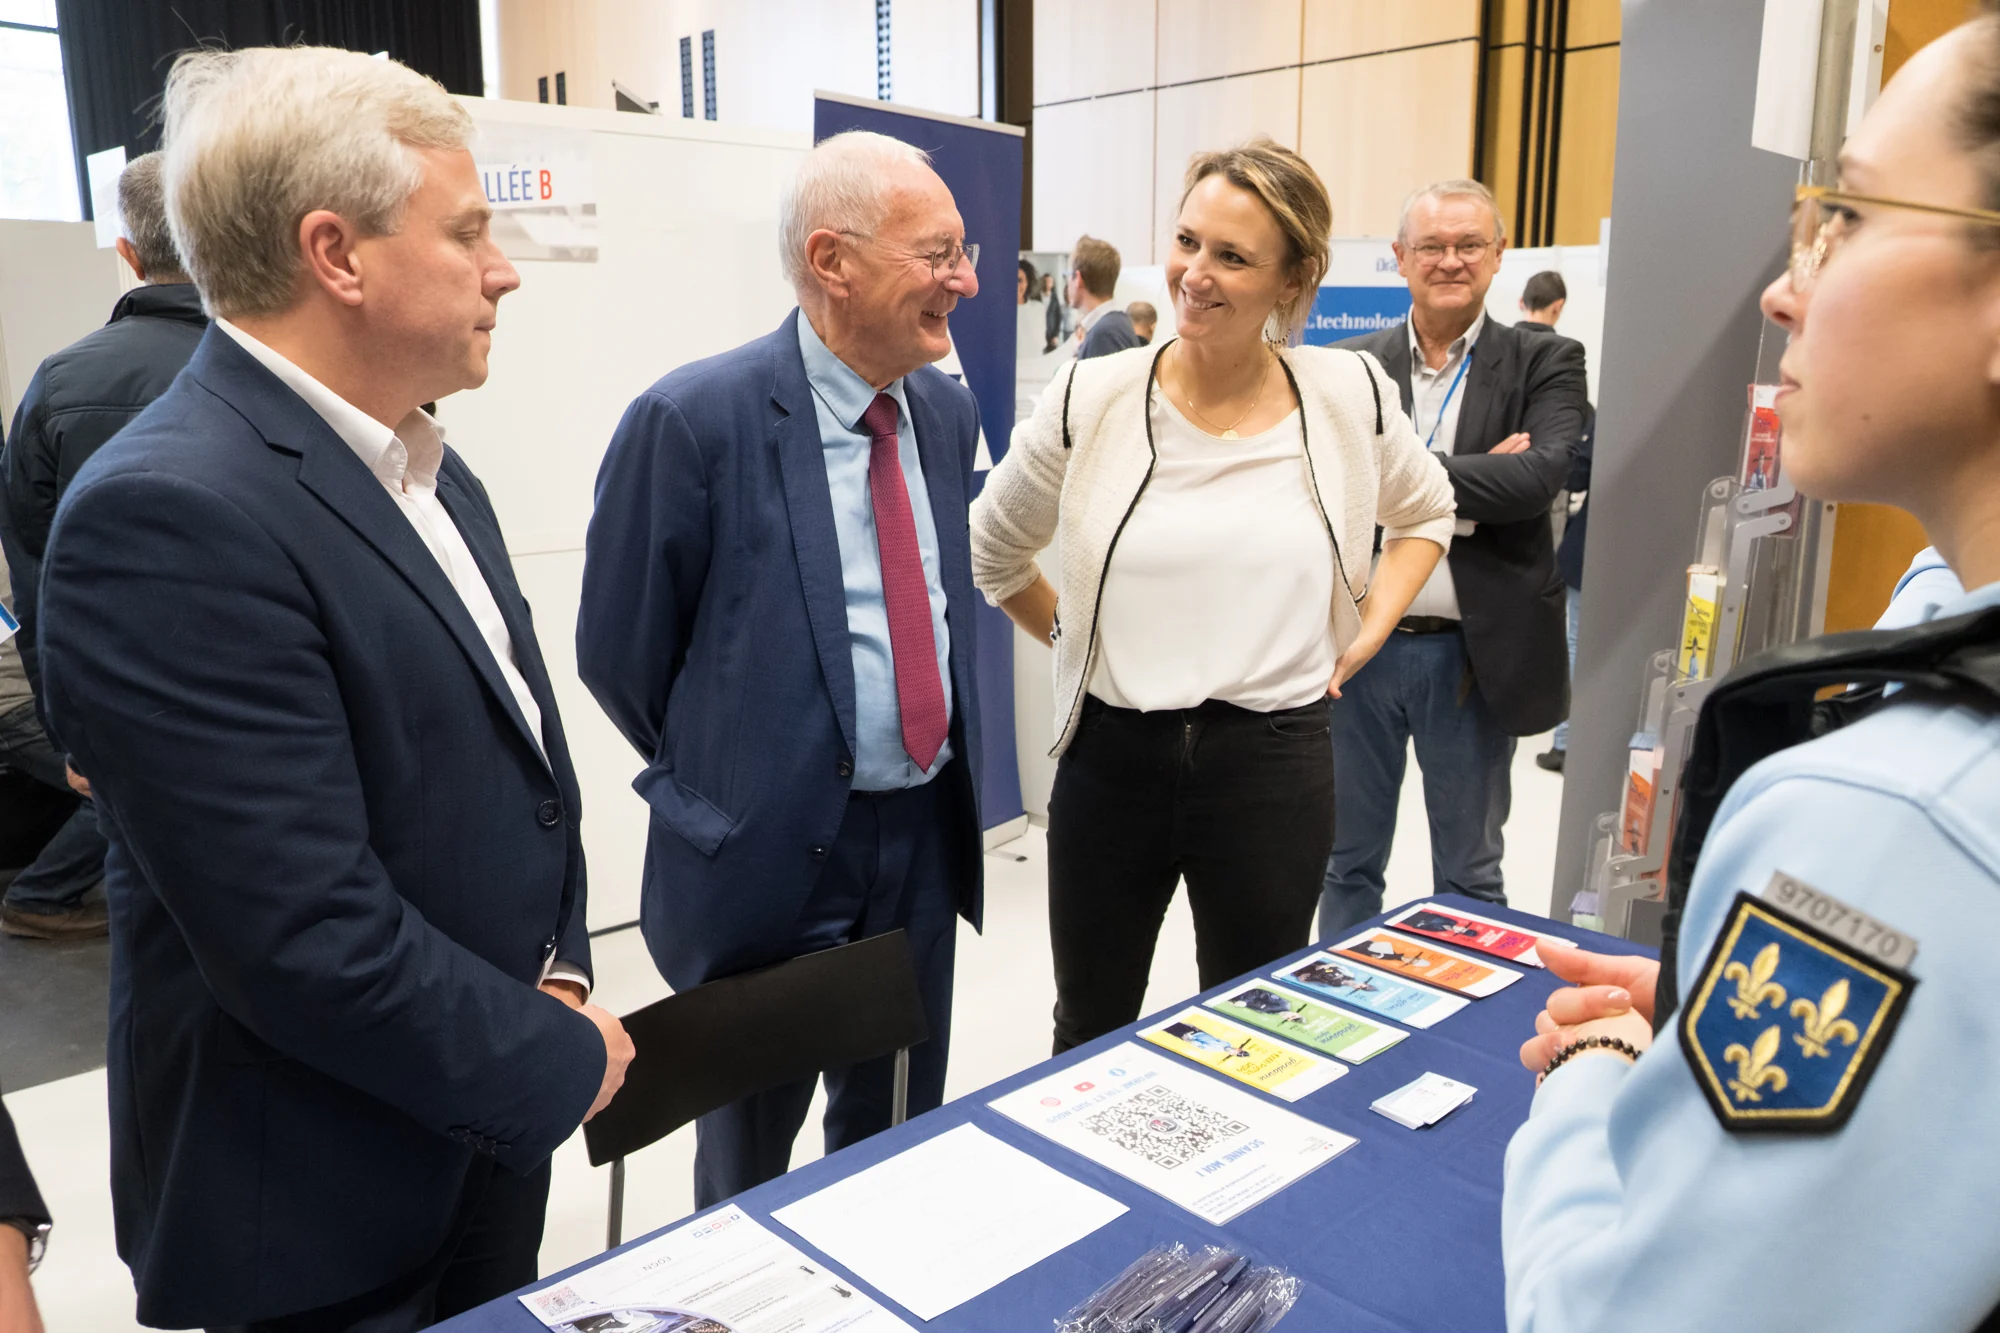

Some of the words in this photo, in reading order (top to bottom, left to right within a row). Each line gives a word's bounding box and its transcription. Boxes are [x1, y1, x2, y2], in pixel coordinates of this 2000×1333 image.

[484, 164, 533, 203] LLÉE
[539, 169, 553, 200] B
[1777, 879, 1901, 958] 9707170
[1122, 1070, 1159, 1089] INFORME
[1258, 1057, 1298, 1082] gendarme
[1046, 1110, 1073, 1124] NOUS
[1072, 1100, 1094, 1113] SUIS
[1222, 1139, 1265, 1163] SCANNE
[1200, 1160, 1225, 1174] MOI
